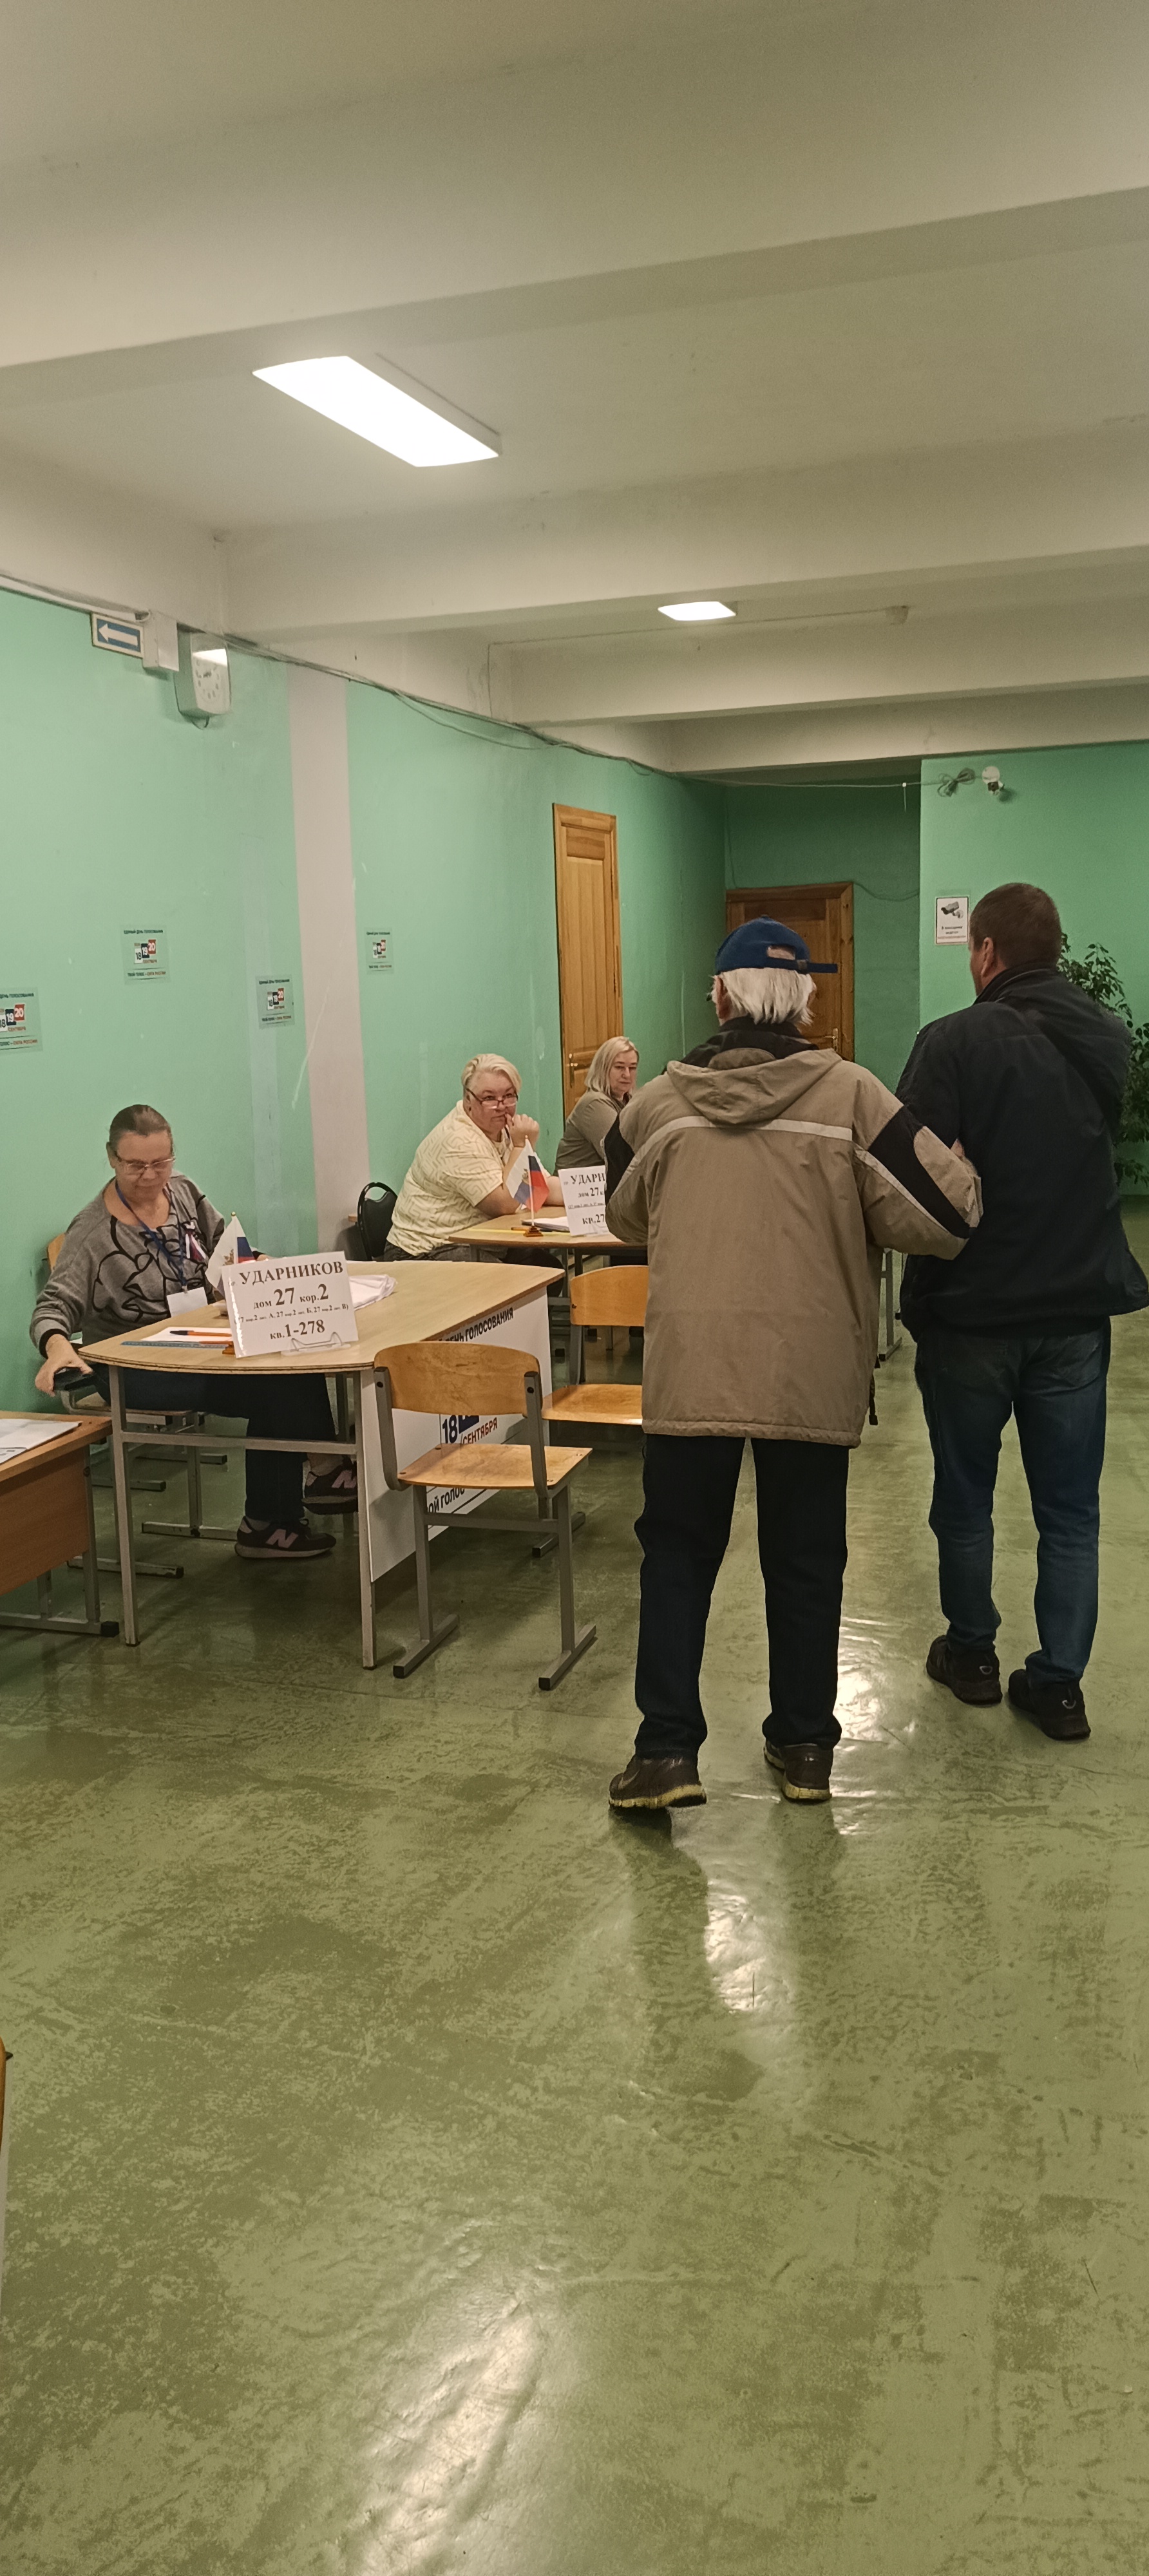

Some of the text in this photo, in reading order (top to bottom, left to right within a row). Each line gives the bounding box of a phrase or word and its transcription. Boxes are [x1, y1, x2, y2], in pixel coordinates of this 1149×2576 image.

[135, 952, 142, 960] 18
[142, 947, 148, 956] 19
[147, 942, 155, 951] 20
[6, 1012, 14, 1023] 19
[14, 1007, 24, 1018] 20
[590, 1187, 599, 1197] 27
[239, 1261, 343, 1286] УДАРНИКОВ
[253, 1283, 329, 1310] дом 27 кор.2
[270, 1319, 325, 1340] кв.1-278
[465, 1307, 513, 1341] ГОЛОСОВАНИЯ
[442, 1415, 458, 1443] 18
[462, 1417, 498, 1444] СЕНТЯБРЯ
[265, 1528, 299, 1549] N
